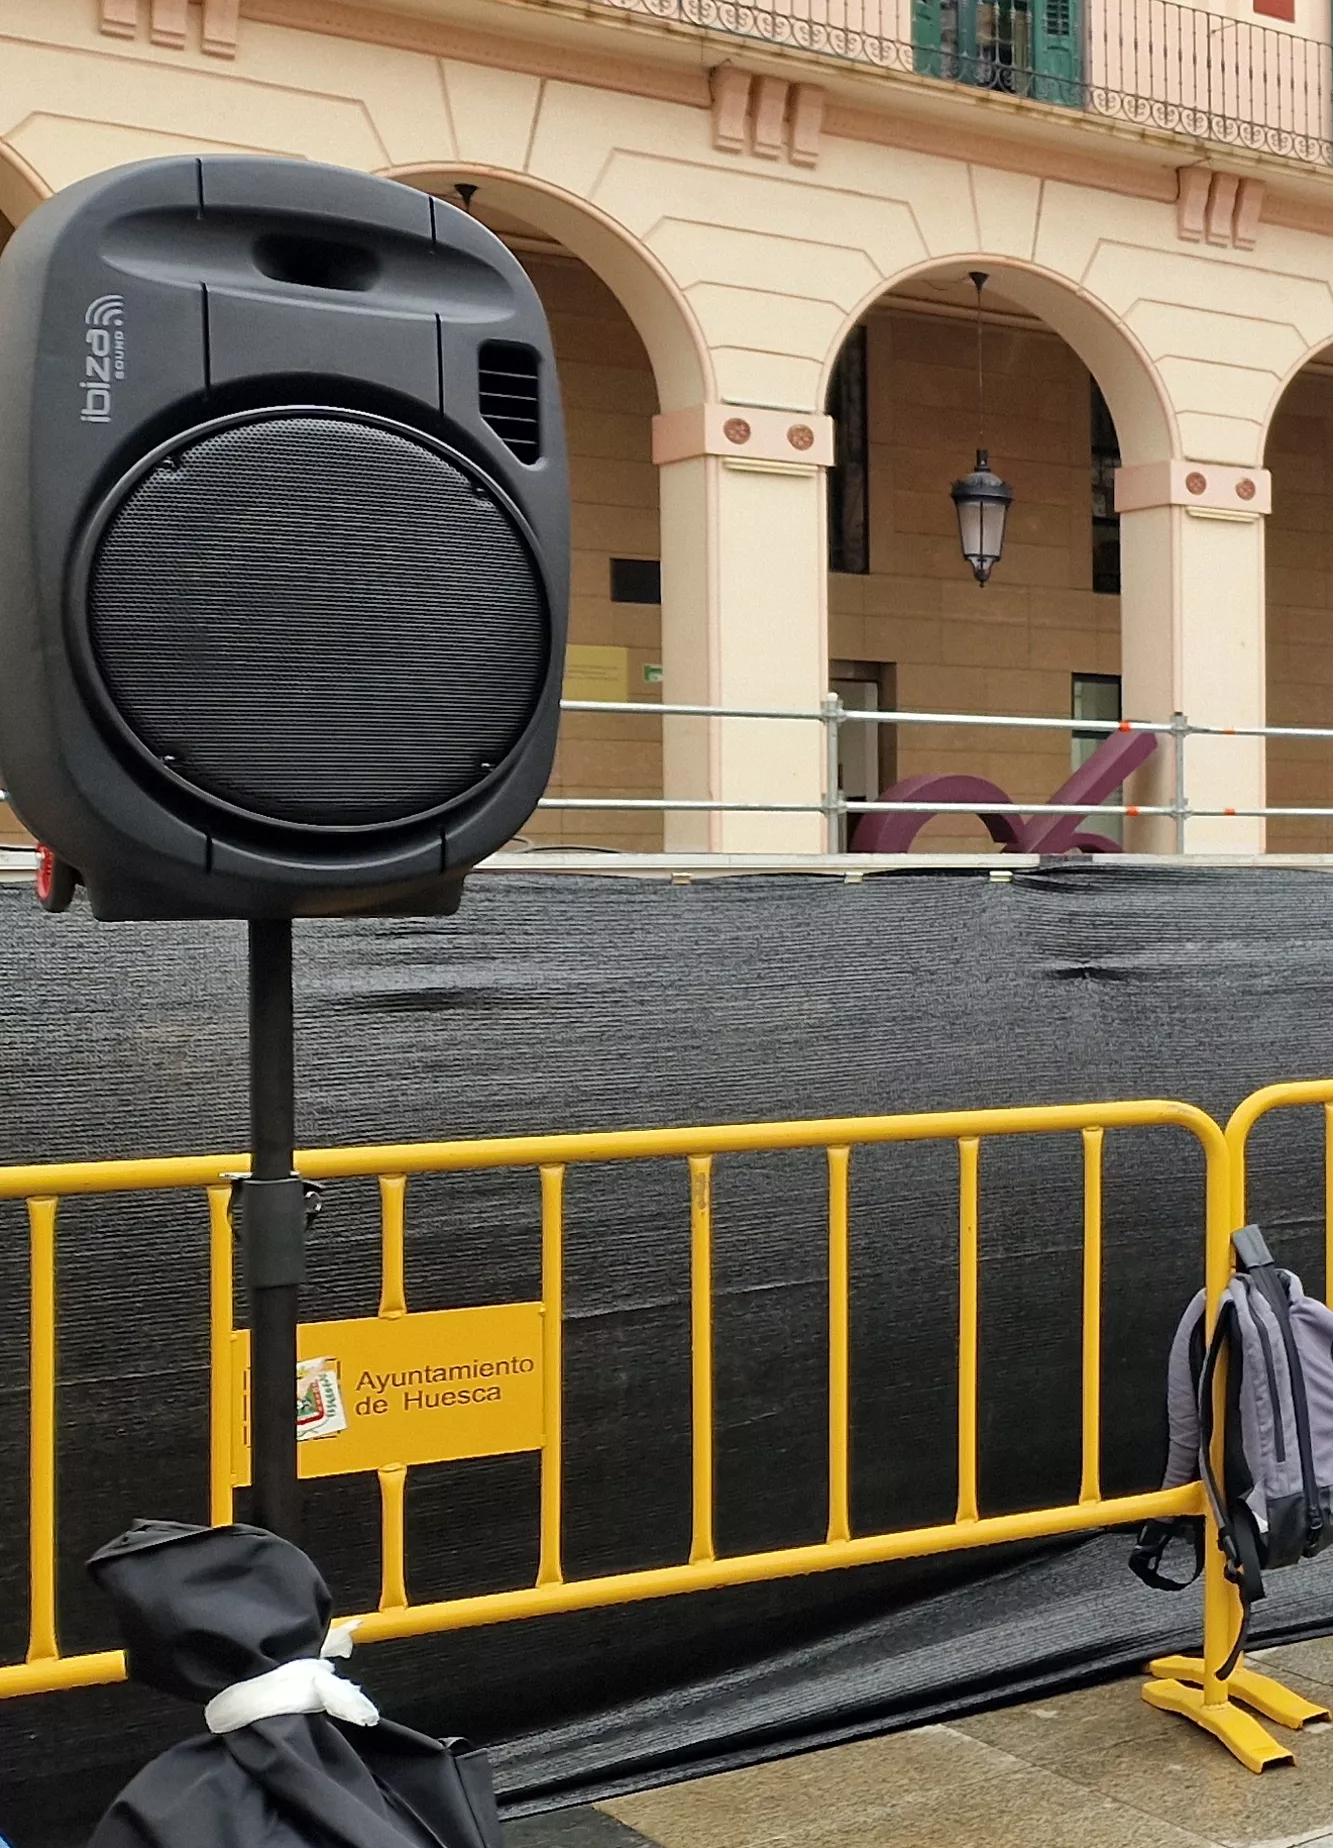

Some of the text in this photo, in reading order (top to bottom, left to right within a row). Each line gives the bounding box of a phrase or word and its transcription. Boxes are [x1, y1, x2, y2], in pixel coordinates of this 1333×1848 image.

[80, 328, 111, 422] ibiza
[114, 330, 125, 380] SOUND
[355, 1355, 534, 1394] Ayuntamiento
[355, 1384, 502, 1417] de Huesca
